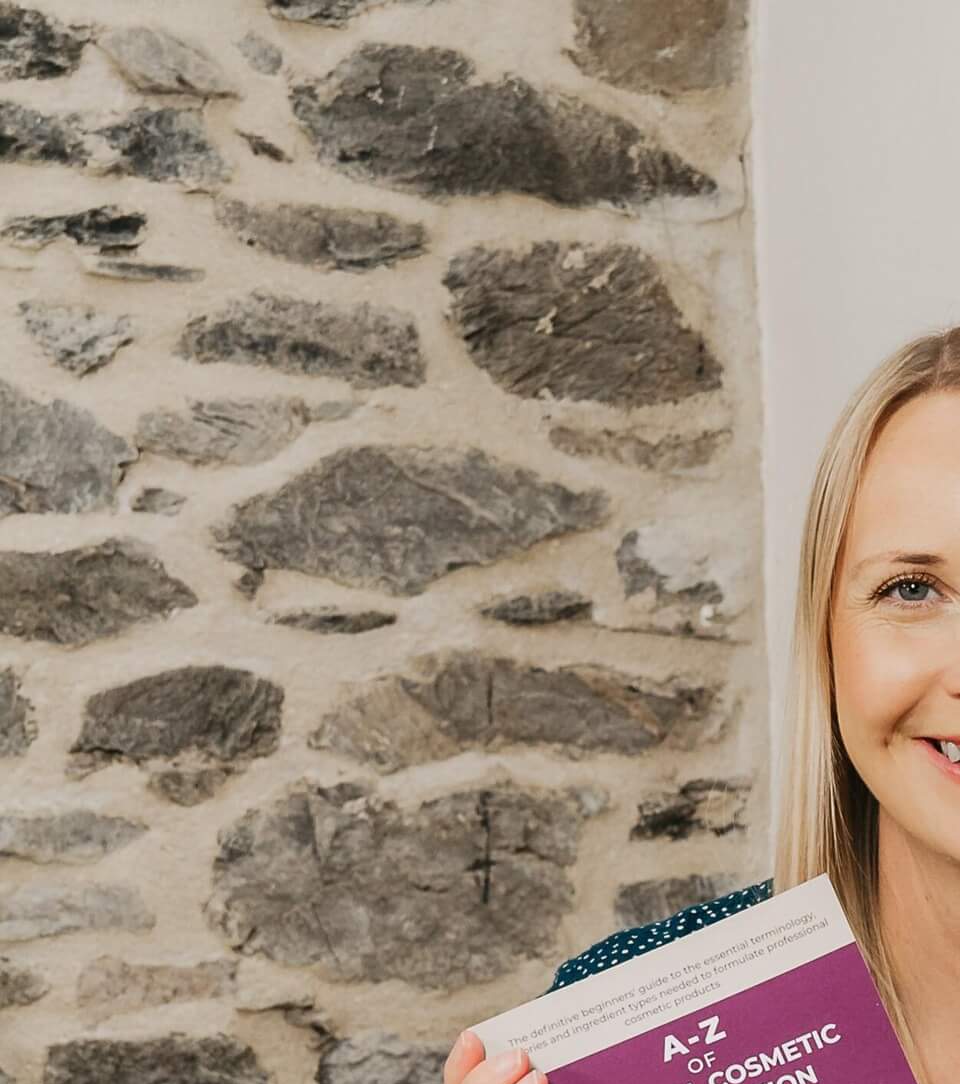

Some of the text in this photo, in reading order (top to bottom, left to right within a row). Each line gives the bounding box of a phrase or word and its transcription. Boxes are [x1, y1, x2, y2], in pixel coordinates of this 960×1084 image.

[508, 1036, 529, 1047] The
[531, 1014, 580, 1039] definitive
[638, 976, 669, 995] guide
[670, 970, 682, 980] to
[683, 962, 701, 975] the
[703, 940, 749, 964] essential
[750, 911, 816, 945] terminology,
[550, 1029, 571, 1045] and
[572, 1008, 625, 1034] ingredient
[628, 993, 657, 1012] types
[660, 976, 699, 998] needed
[700, 971, 713, 982] to
[714, 948, 765, 975] formulate
[766, 918, 829, 953] professional
[625, 981, 721, 1026] cosmetic products
[663, 1015, 727, 1063] A-Z
[687, 1051, 717, 1074] OF
